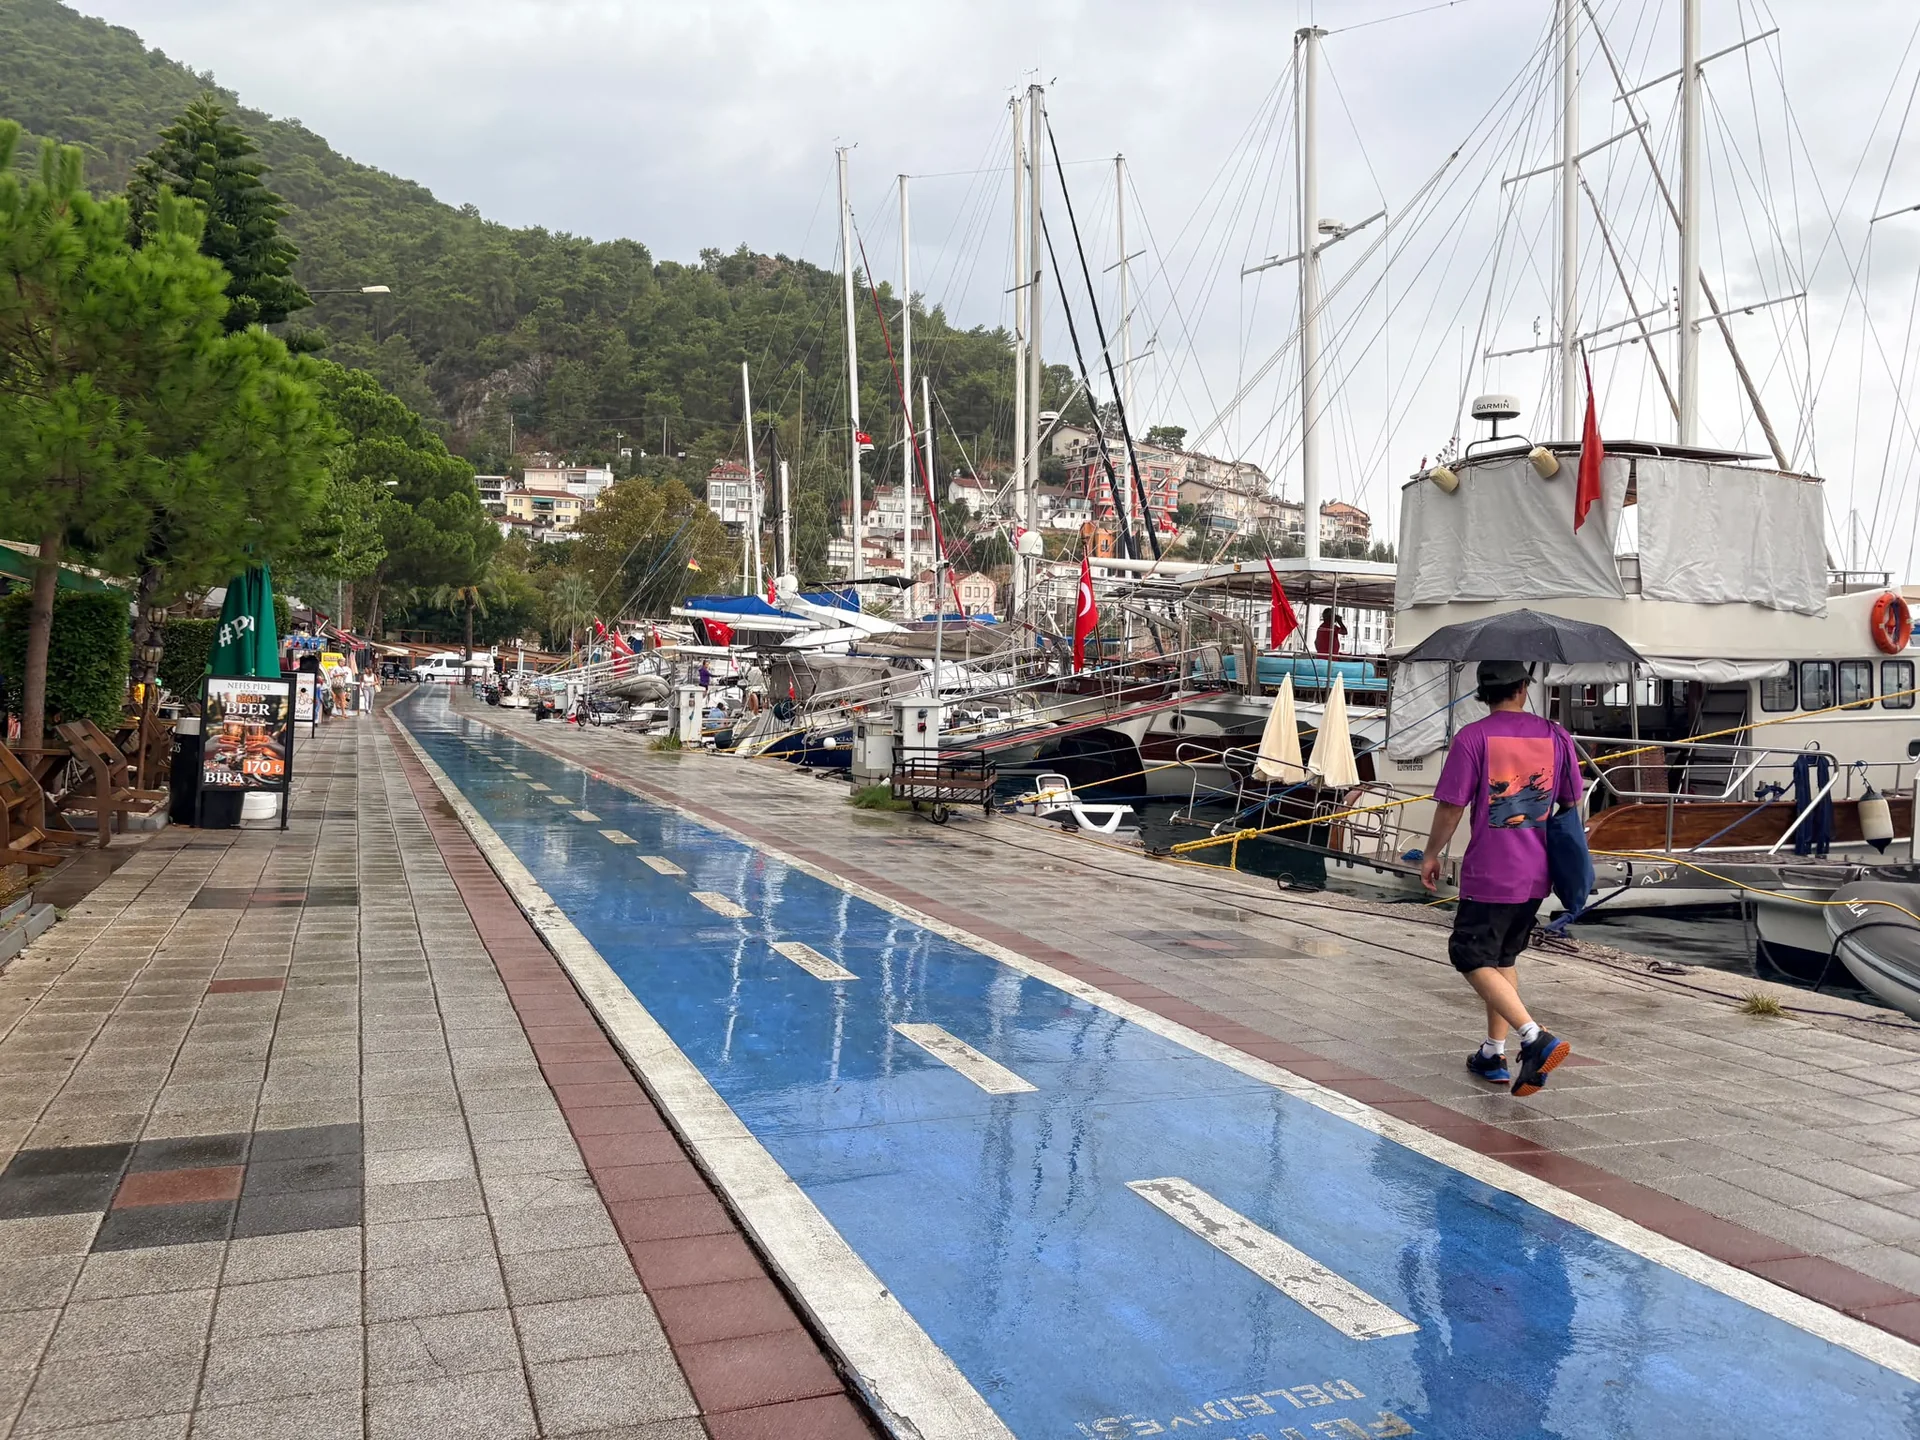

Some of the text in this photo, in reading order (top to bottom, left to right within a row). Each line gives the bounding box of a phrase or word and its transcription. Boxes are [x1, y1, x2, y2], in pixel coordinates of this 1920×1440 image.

[1476, 402, 1510, 411] GARMIN
[225, 702, 271, 716] BEER
[246, 761, 271, 773] 170
[204, 769, 245, 784] BİRA
